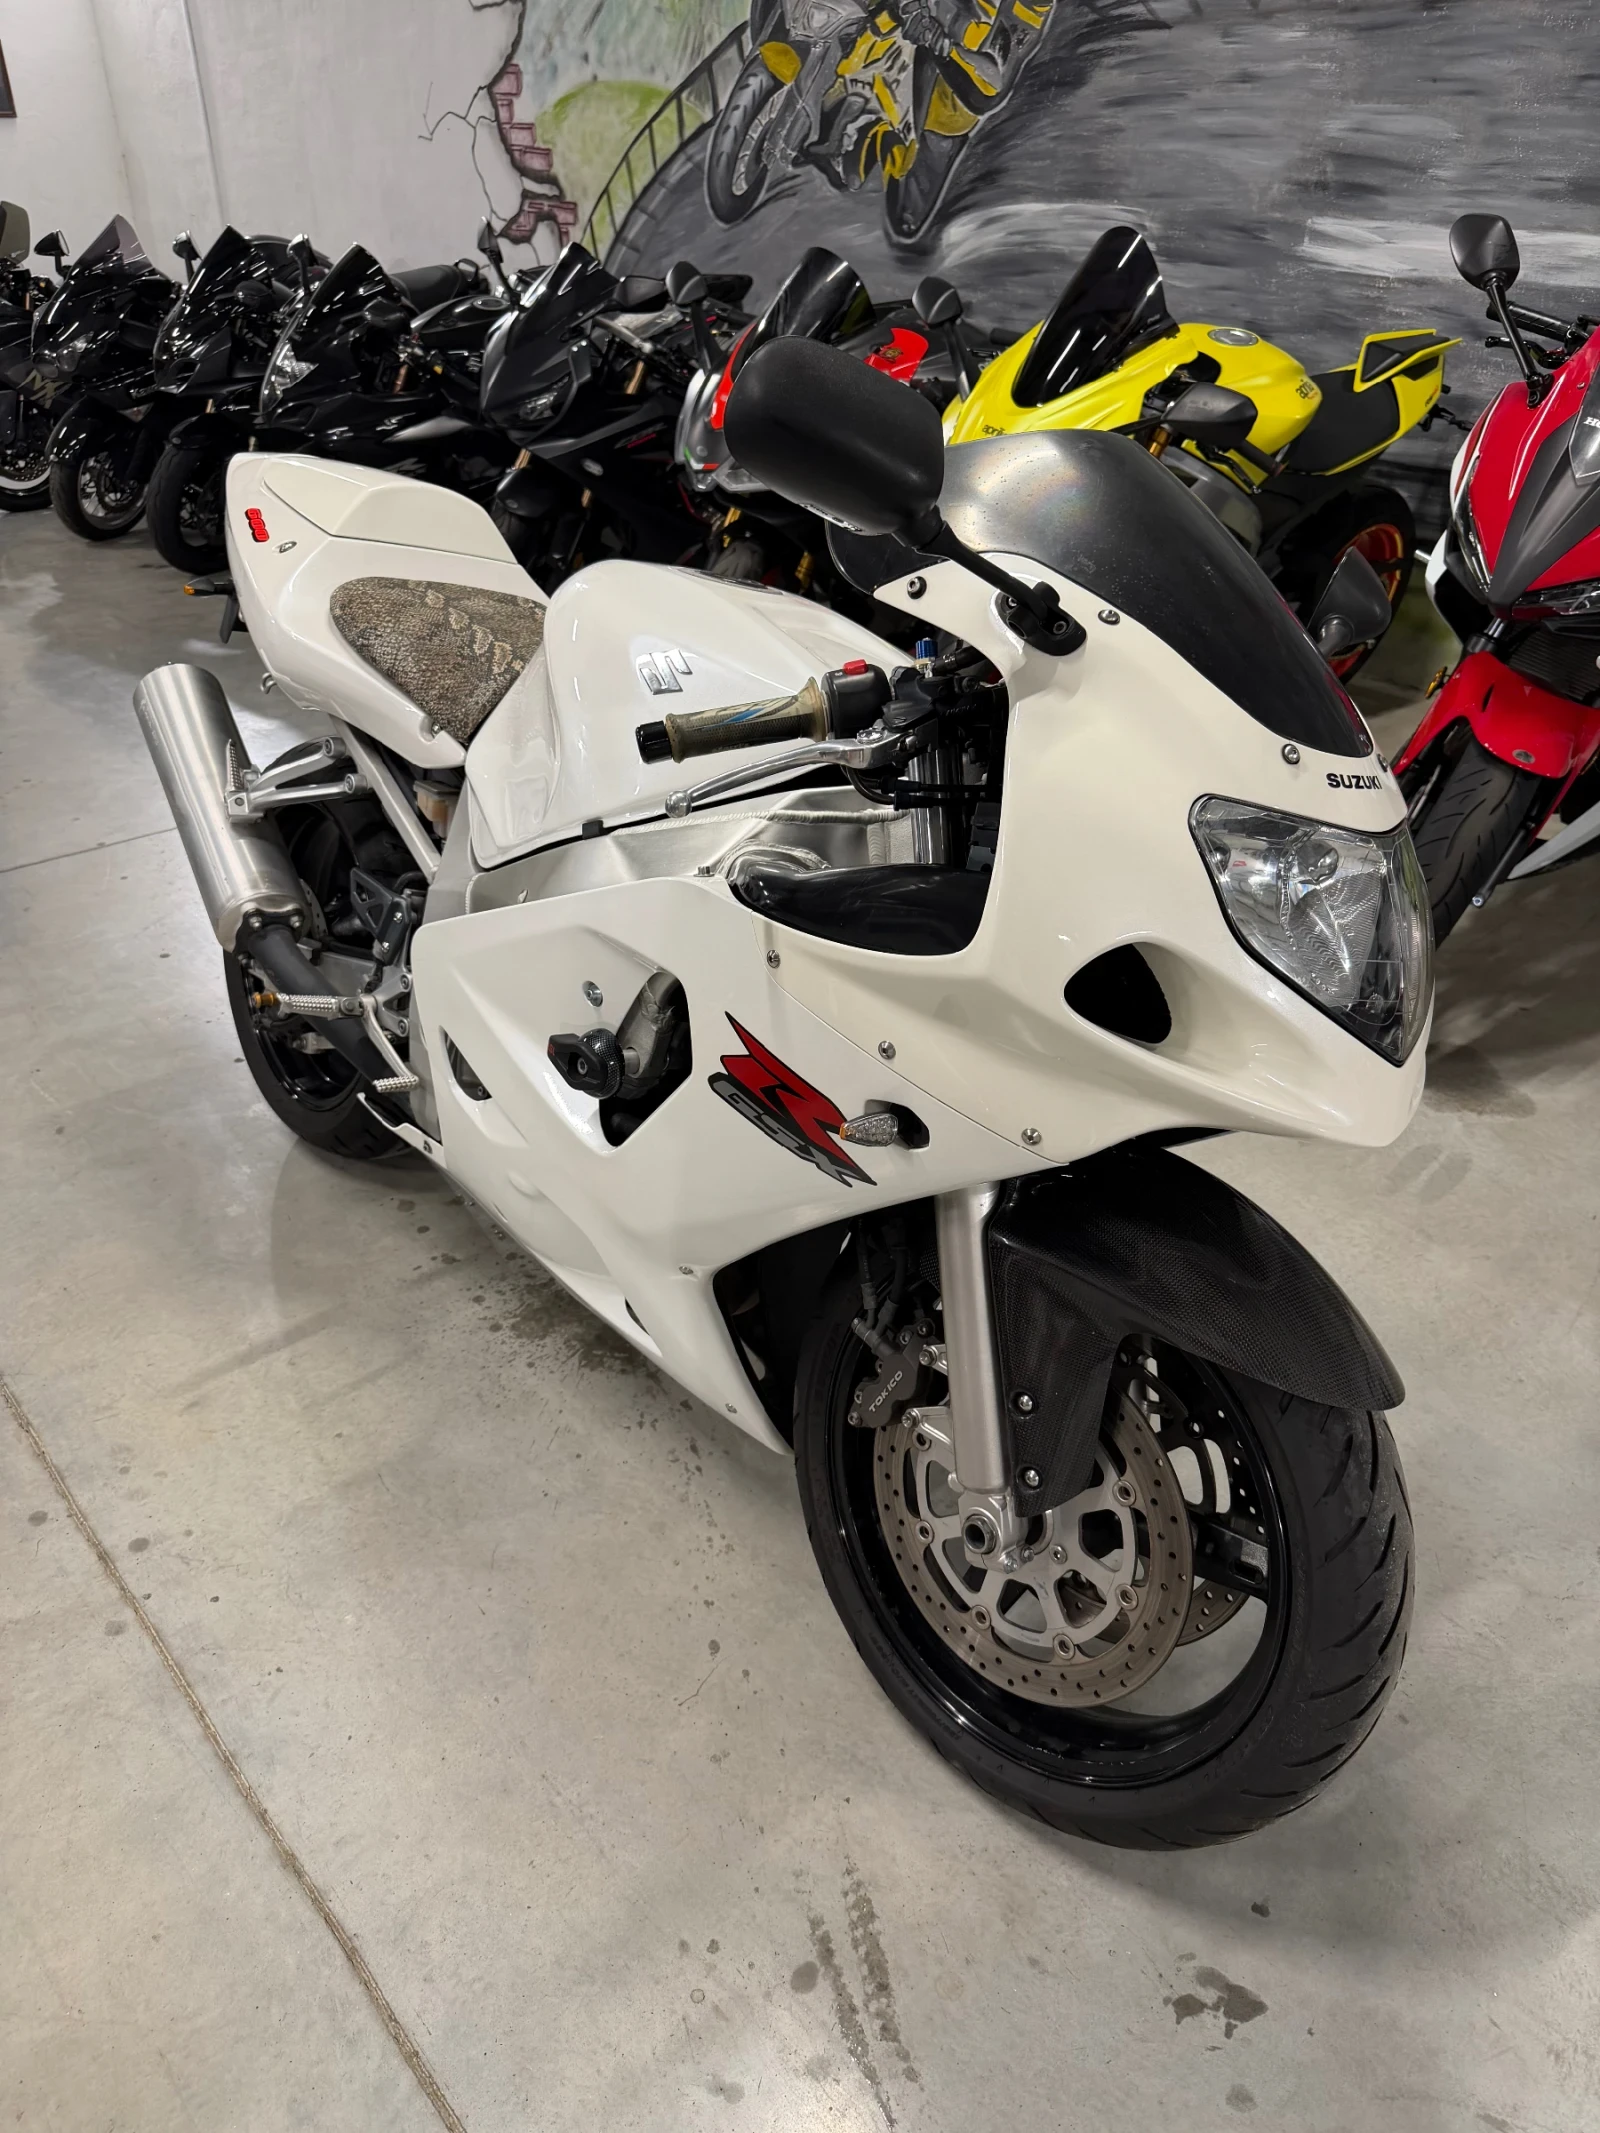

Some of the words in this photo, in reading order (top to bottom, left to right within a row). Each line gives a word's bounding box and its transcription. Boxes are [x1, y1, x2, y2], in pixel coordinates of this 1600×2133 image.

[244, 508, 270, 543] 600
[1326, 773, 1382, 790] SUZUKI
[868, 1370, 903, 1412] TOKICO
